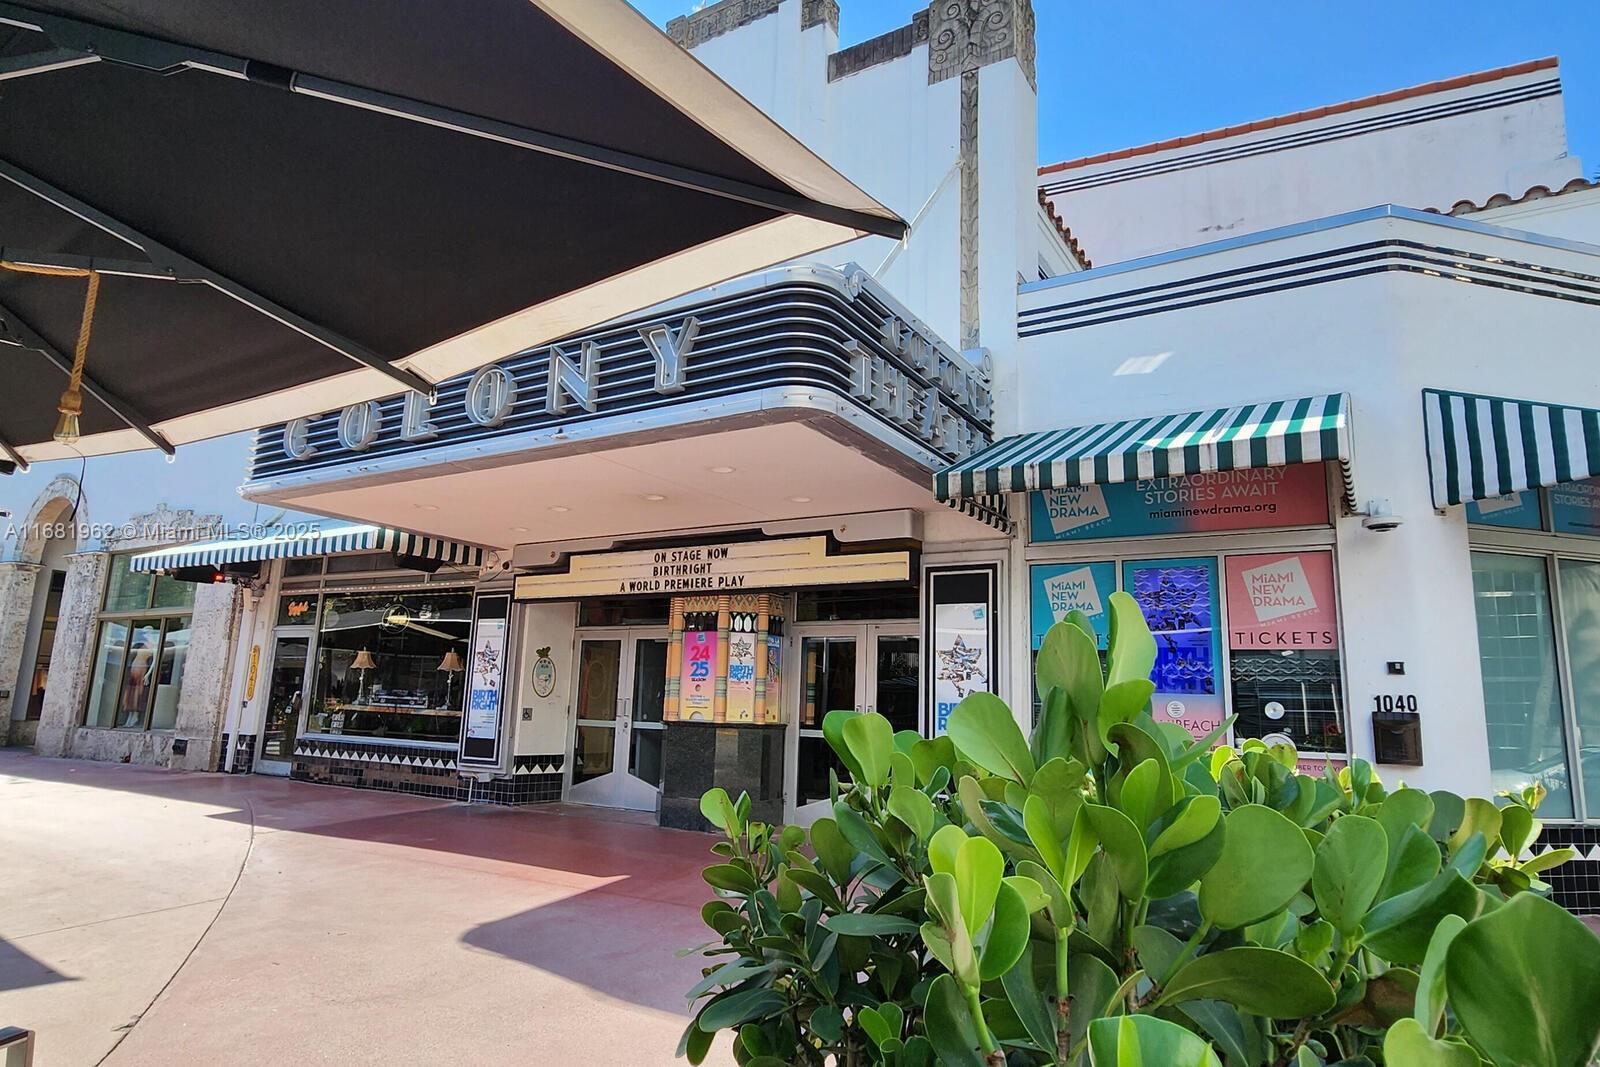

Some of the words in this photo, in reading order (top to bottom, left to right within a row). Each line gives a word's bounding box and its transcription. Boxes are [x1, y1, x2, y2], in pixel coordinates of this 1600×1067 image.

[283, 316, 701, 461] COLONY
[1136, 466, 1288, 492] EXTRAORDINARY
[1144, 487, 1216, 505] STORIES
[1221, 481, 1279, 499] AWAIT
[1050, 494, 1081, 507] NEW
[1050, 505, 1099, 518] DRAMA
[1149, 503, 1277, 519] miaminewdrama.org
[654, 552, 667, 563] ON
[671, 550, 701, 562] STAGE
[707, 547, 729, 559] NOW
[653, 563, 712, 576] BIRTHRIGHT
[620, 582, 626, 592] A
[629, 580, 660, 592] WORLD
[664, 577, 713, 590] PREMIERE
[718, 575, 745, 587] PLAY
[1253, 584, 1286, 596] NEW
[1051, 591, 1079, 602] NEW
[1253, 596, 1306, 607] DRAMA
[1051, 602, 1095, 612] DRAMA
[1235, 631, 1333, 645] TICKETS
[689, 645, 710, 661] 24
[689, 661, 709, 677] 25
[472, 689, 497, 700] BIRTH
[472, 700, 498, 711] RIGHT
[1373, 694, 1417, 712] 1040
